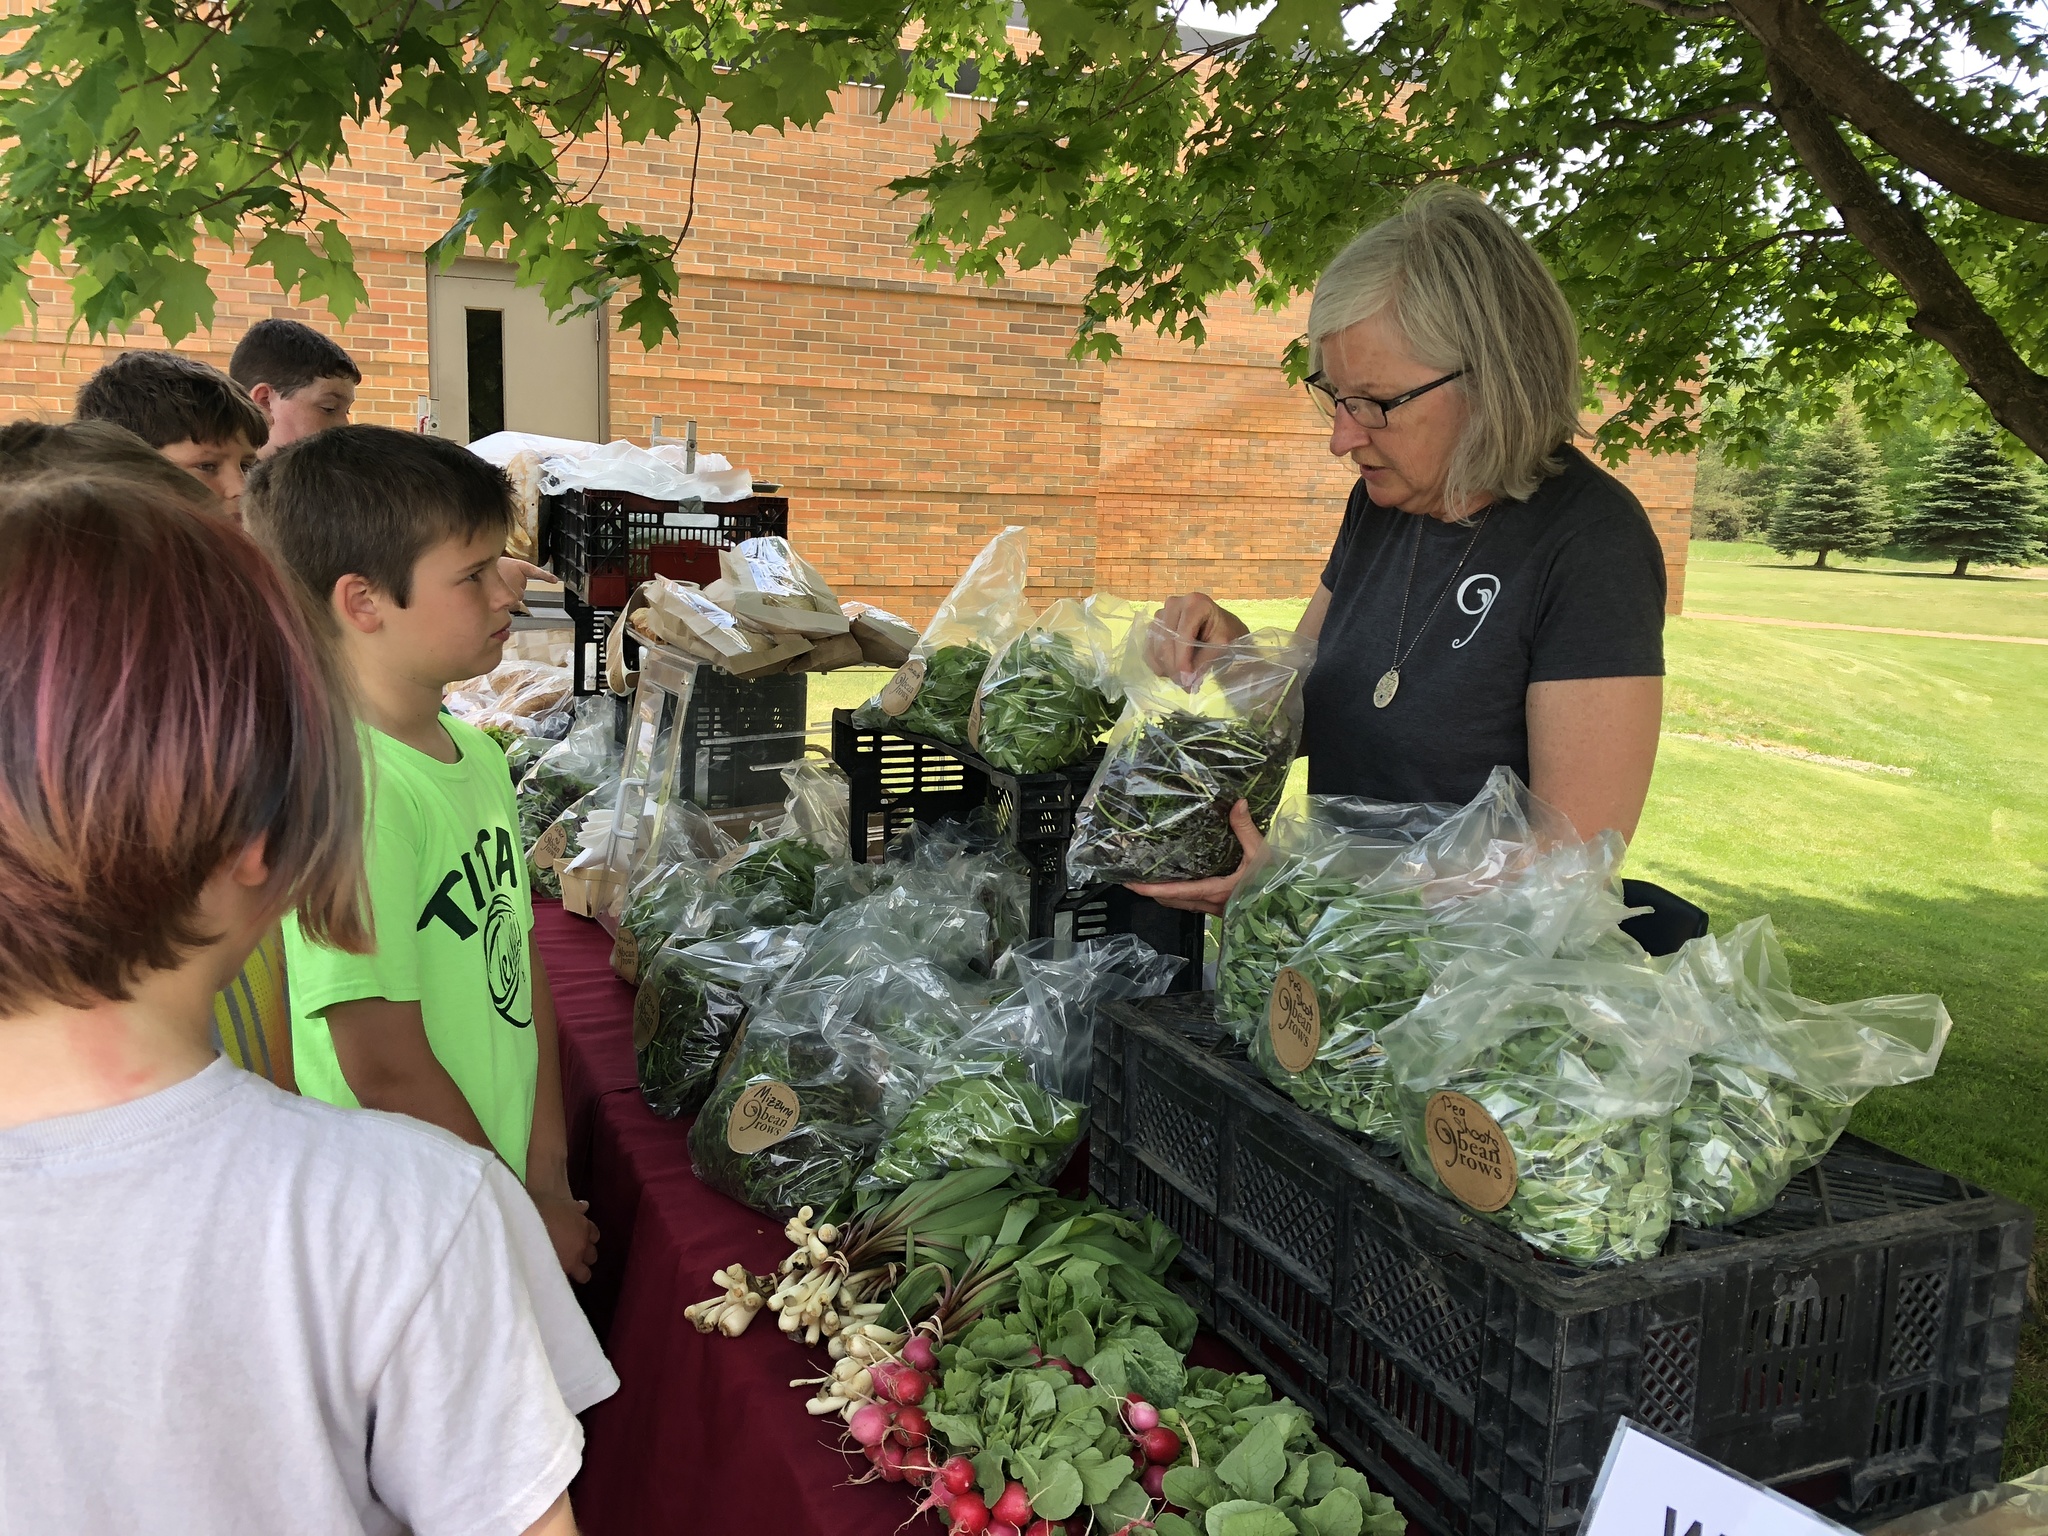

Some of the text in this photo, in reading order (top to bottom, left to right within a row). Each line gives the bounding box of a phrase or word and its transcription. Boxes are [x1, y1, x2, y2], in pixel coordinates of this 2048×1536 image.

[417, 827, 517, 941] TITA
[1291, 1000, 1312, 1035] bean
[1288, 1019, 1309, 1047] rows
[761, 1107, 788, 1128] bean
[1441, 1095, 1466, 1117] Pea
[754, 1121, 782, 1136] rows
[1457, 1130, 1502, 1165] bean
[1460, 1153, 1503, 1180] rows
